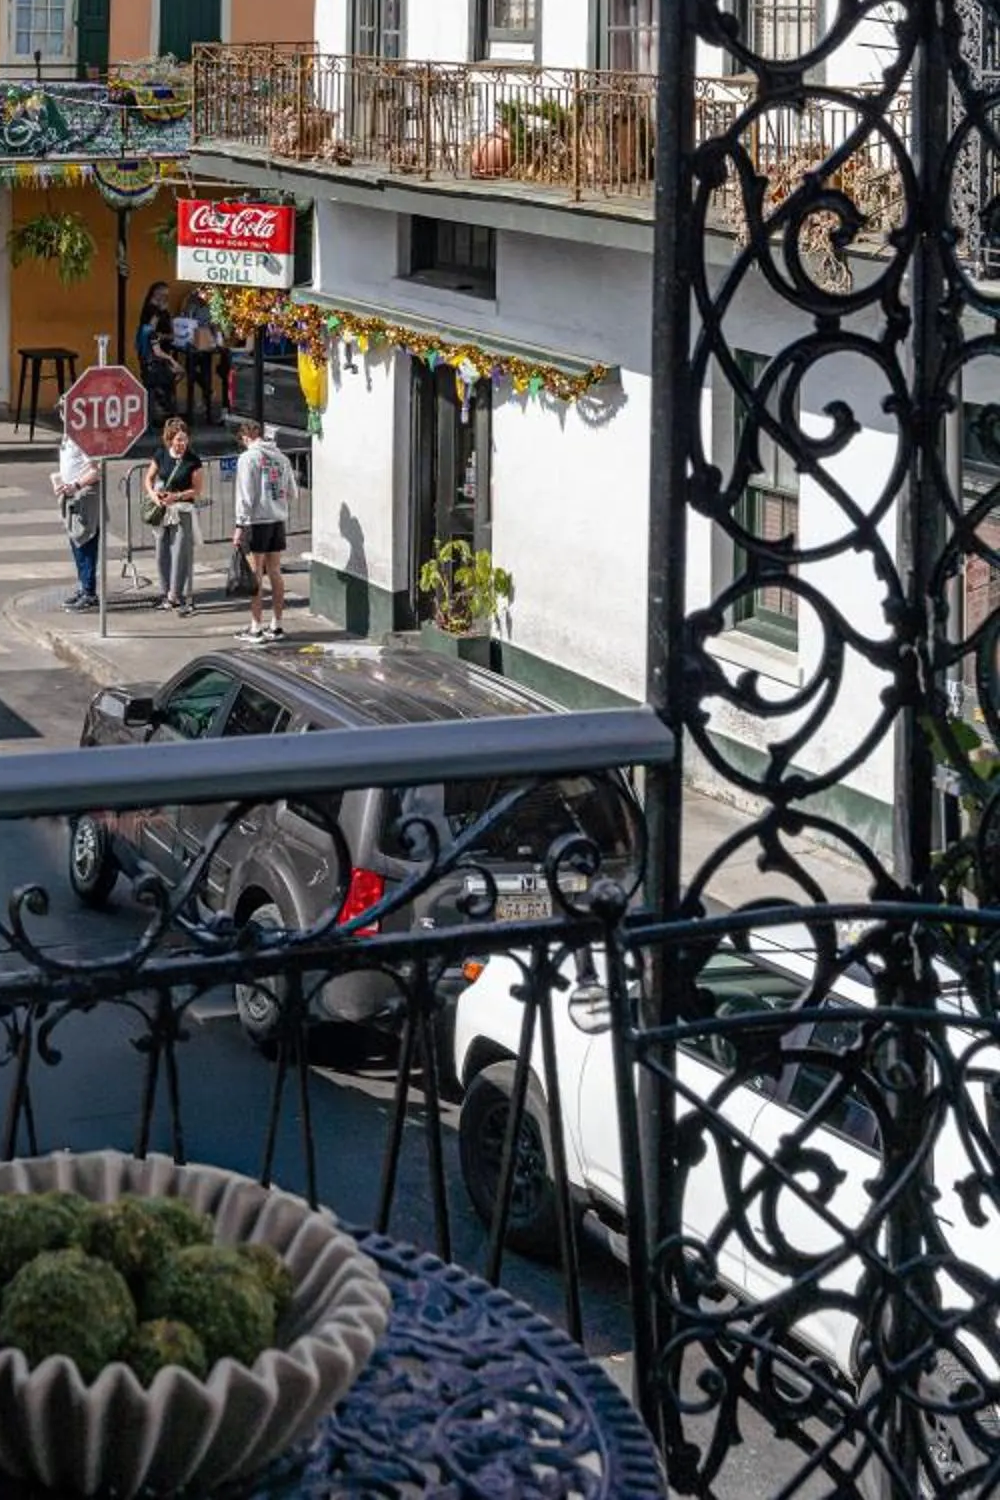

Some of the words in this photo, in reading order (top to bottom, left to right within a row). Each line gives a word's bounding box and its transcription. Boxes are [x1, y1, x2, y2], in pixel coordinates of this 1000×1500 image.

[189, 205, 278, 238] Coca-Cola
[193, 249, 267, 267] CLOVER
[206, 267, 252, 283] GRILL
[70, 394, 141, 431] STOP
